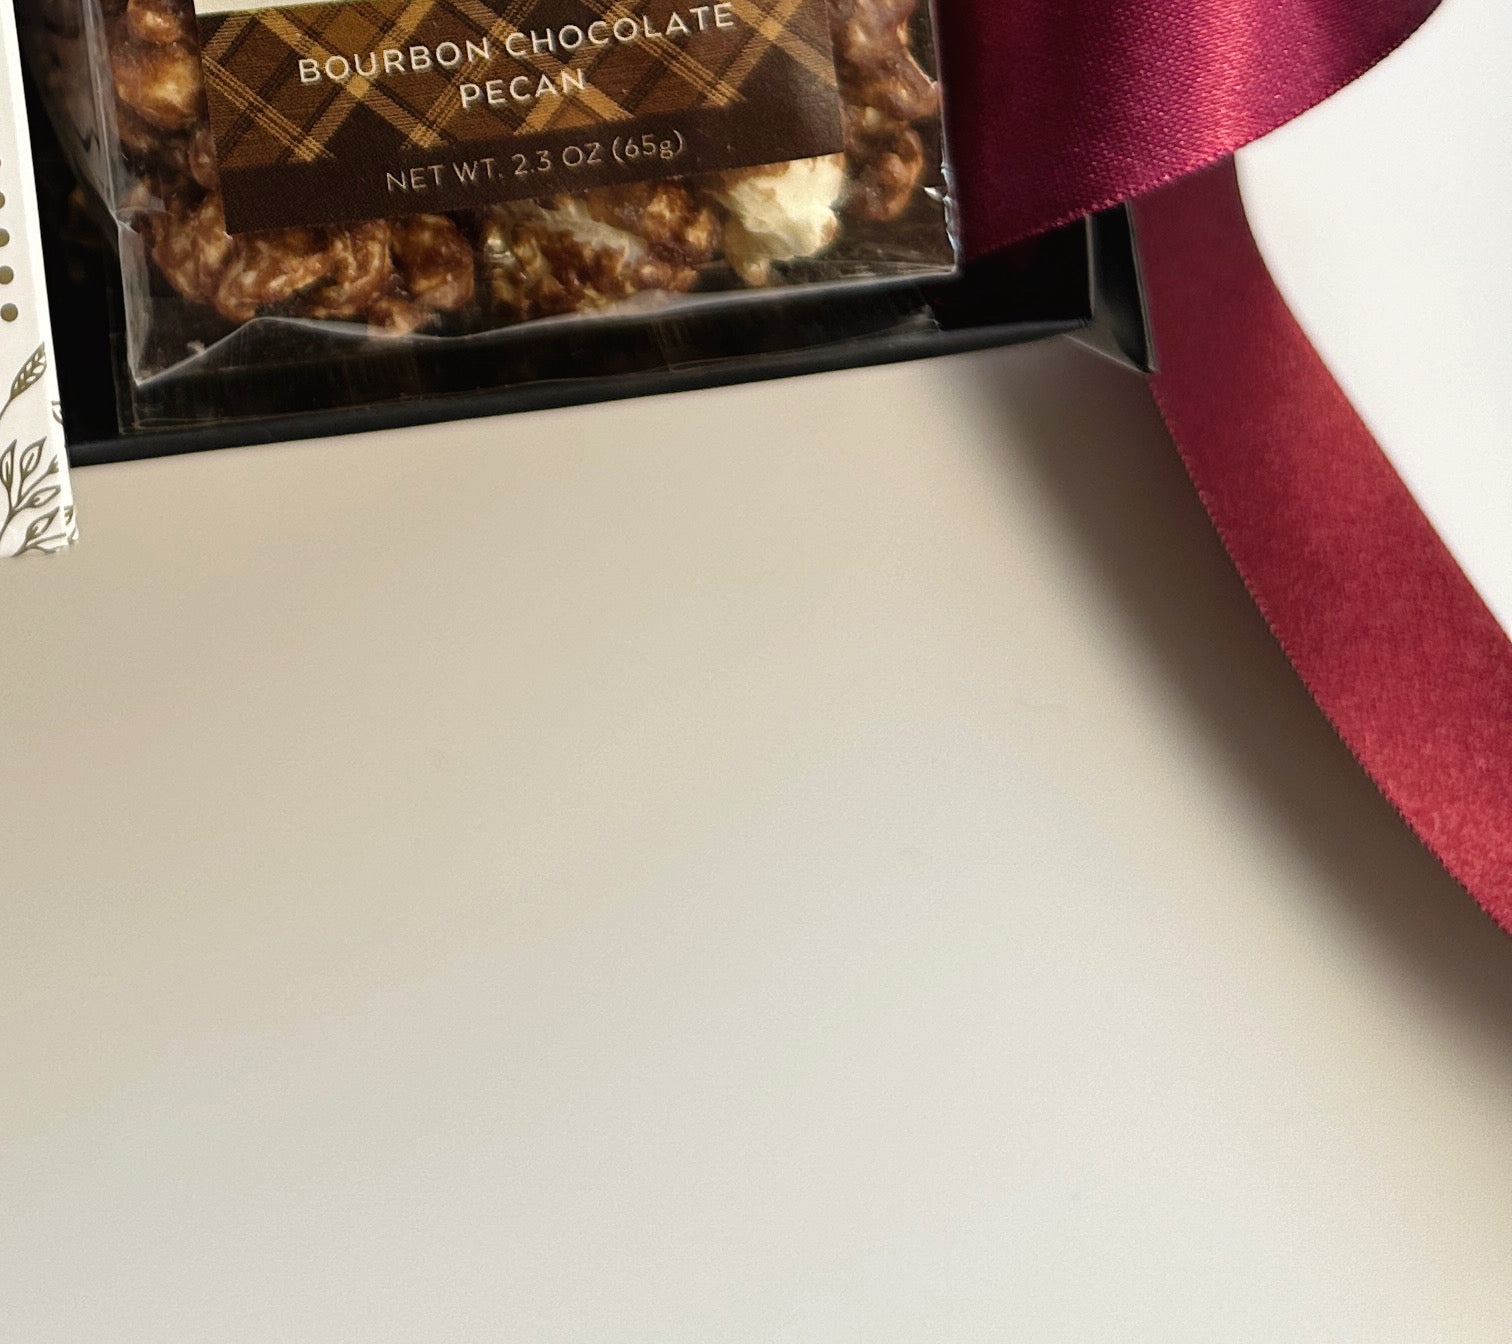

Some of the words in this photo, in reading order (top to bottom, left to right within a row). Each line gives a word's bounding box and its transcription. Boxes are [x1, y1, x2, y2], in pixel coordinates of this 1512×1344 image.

[298, 37, 489, 85] BOURBON
[505, 1, 735, 60] CHOCOLATE
[460, 67, 588, 109] PECAN
[386, 164, 444, 193] NET
[453, 158, 504, 185] WT.
[511, 150, 553, 176] 2.3
[562, 141, 603, 168] OZ
[612, 129, 685, 164] (65g)
